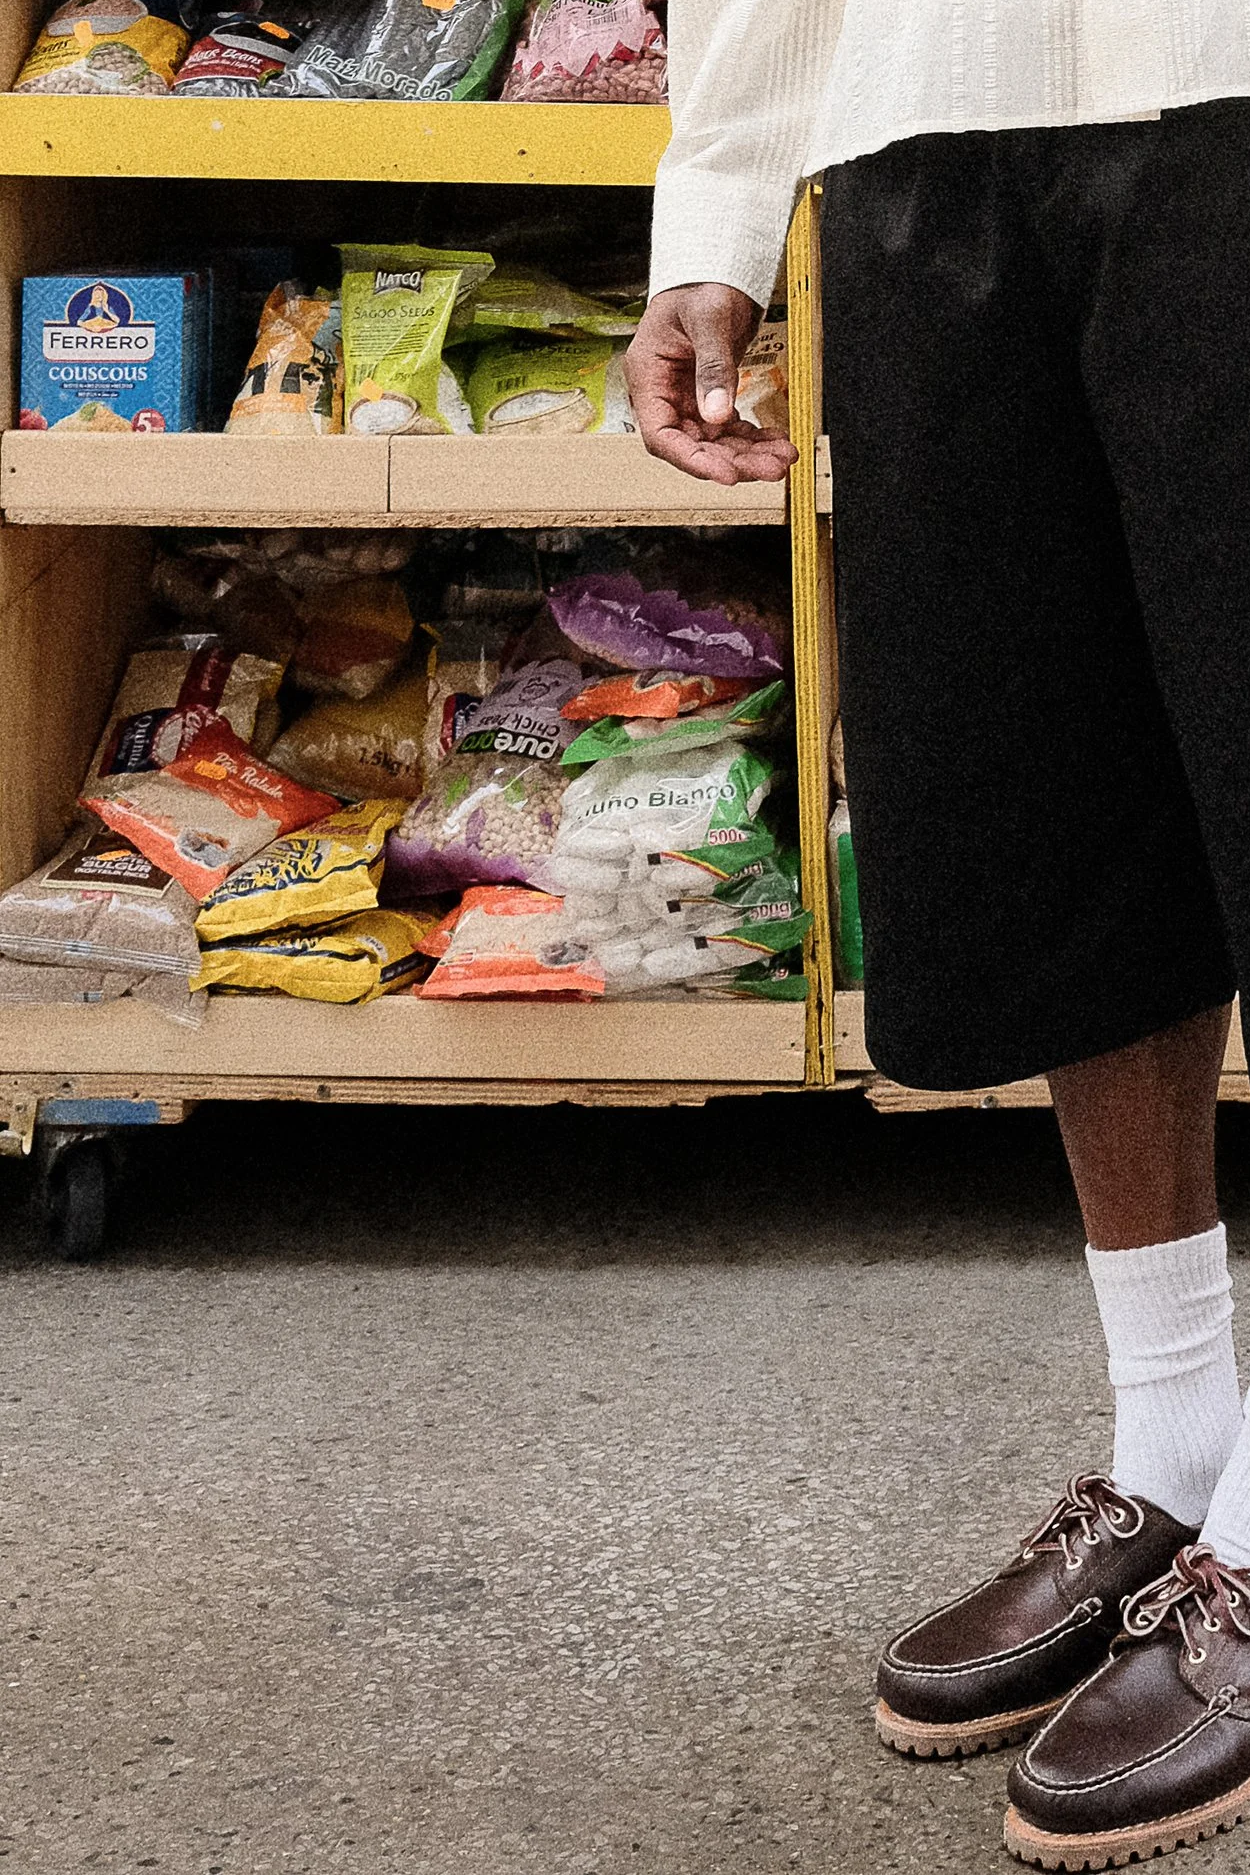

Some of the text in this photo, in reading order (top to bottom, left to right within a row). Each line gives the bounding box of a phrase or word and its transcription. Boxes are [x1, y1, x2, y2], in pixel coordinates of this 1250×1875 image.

[221, 49, 262, 64] Beans
[359, 57, 451, 100] Morado
[376, 271, 422, 288] NATCO
[352, 307, 398, 319] SAGOO
[50, 332, 149, 349] FERRERO
[49, 366, 148, 381] couscous
[136, 412, 152, 433] 5
[214, 752, 284, 798] Pão Ralado
[578, 783, 735, 820] uño Blanco
[82, 860, 152, 873] BULGUR
